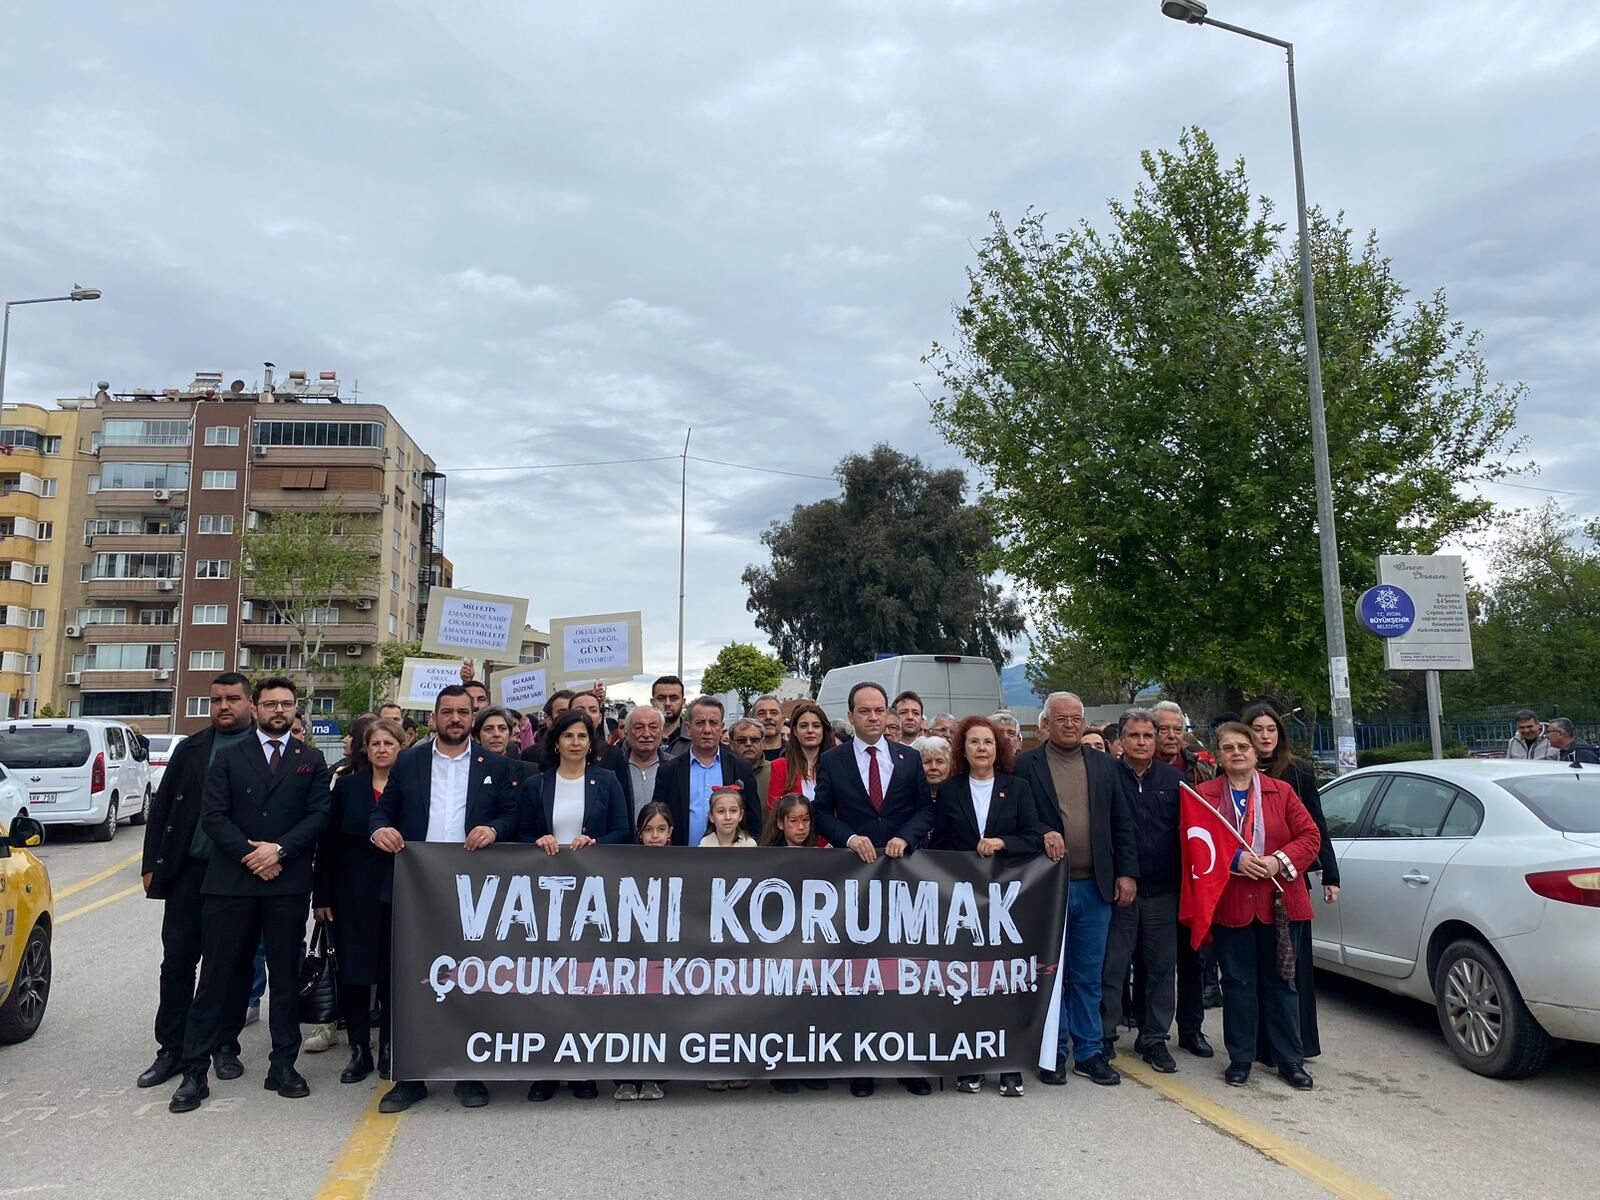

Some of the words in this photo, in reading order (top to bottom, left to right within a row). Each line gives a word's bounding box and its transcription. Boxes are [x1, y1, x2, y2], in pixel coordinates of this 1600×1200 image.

[575, 627, 617, 636] OKULLARDA
[580, 644, 612, 655] GÜVEN
[520, 676, 536, 684] KARA
[456, 874, 683, 943] VATANI
[710, 877, 1024, 946] KORUMAK
[429, 955, 648, 1002] ÇOCUKLARI
[662, 957, 884, 996] KORUMAKLA
[898, 955, 1038, 1005] BAŞLAR!
[466, 1032, 546, 1063] CHP
[553, 1032, 666, 1063] AYDIN
[679, 1025, 843, 1070] GENÇLİK
[854, 1029, 1006, 1062] KOLLARI
